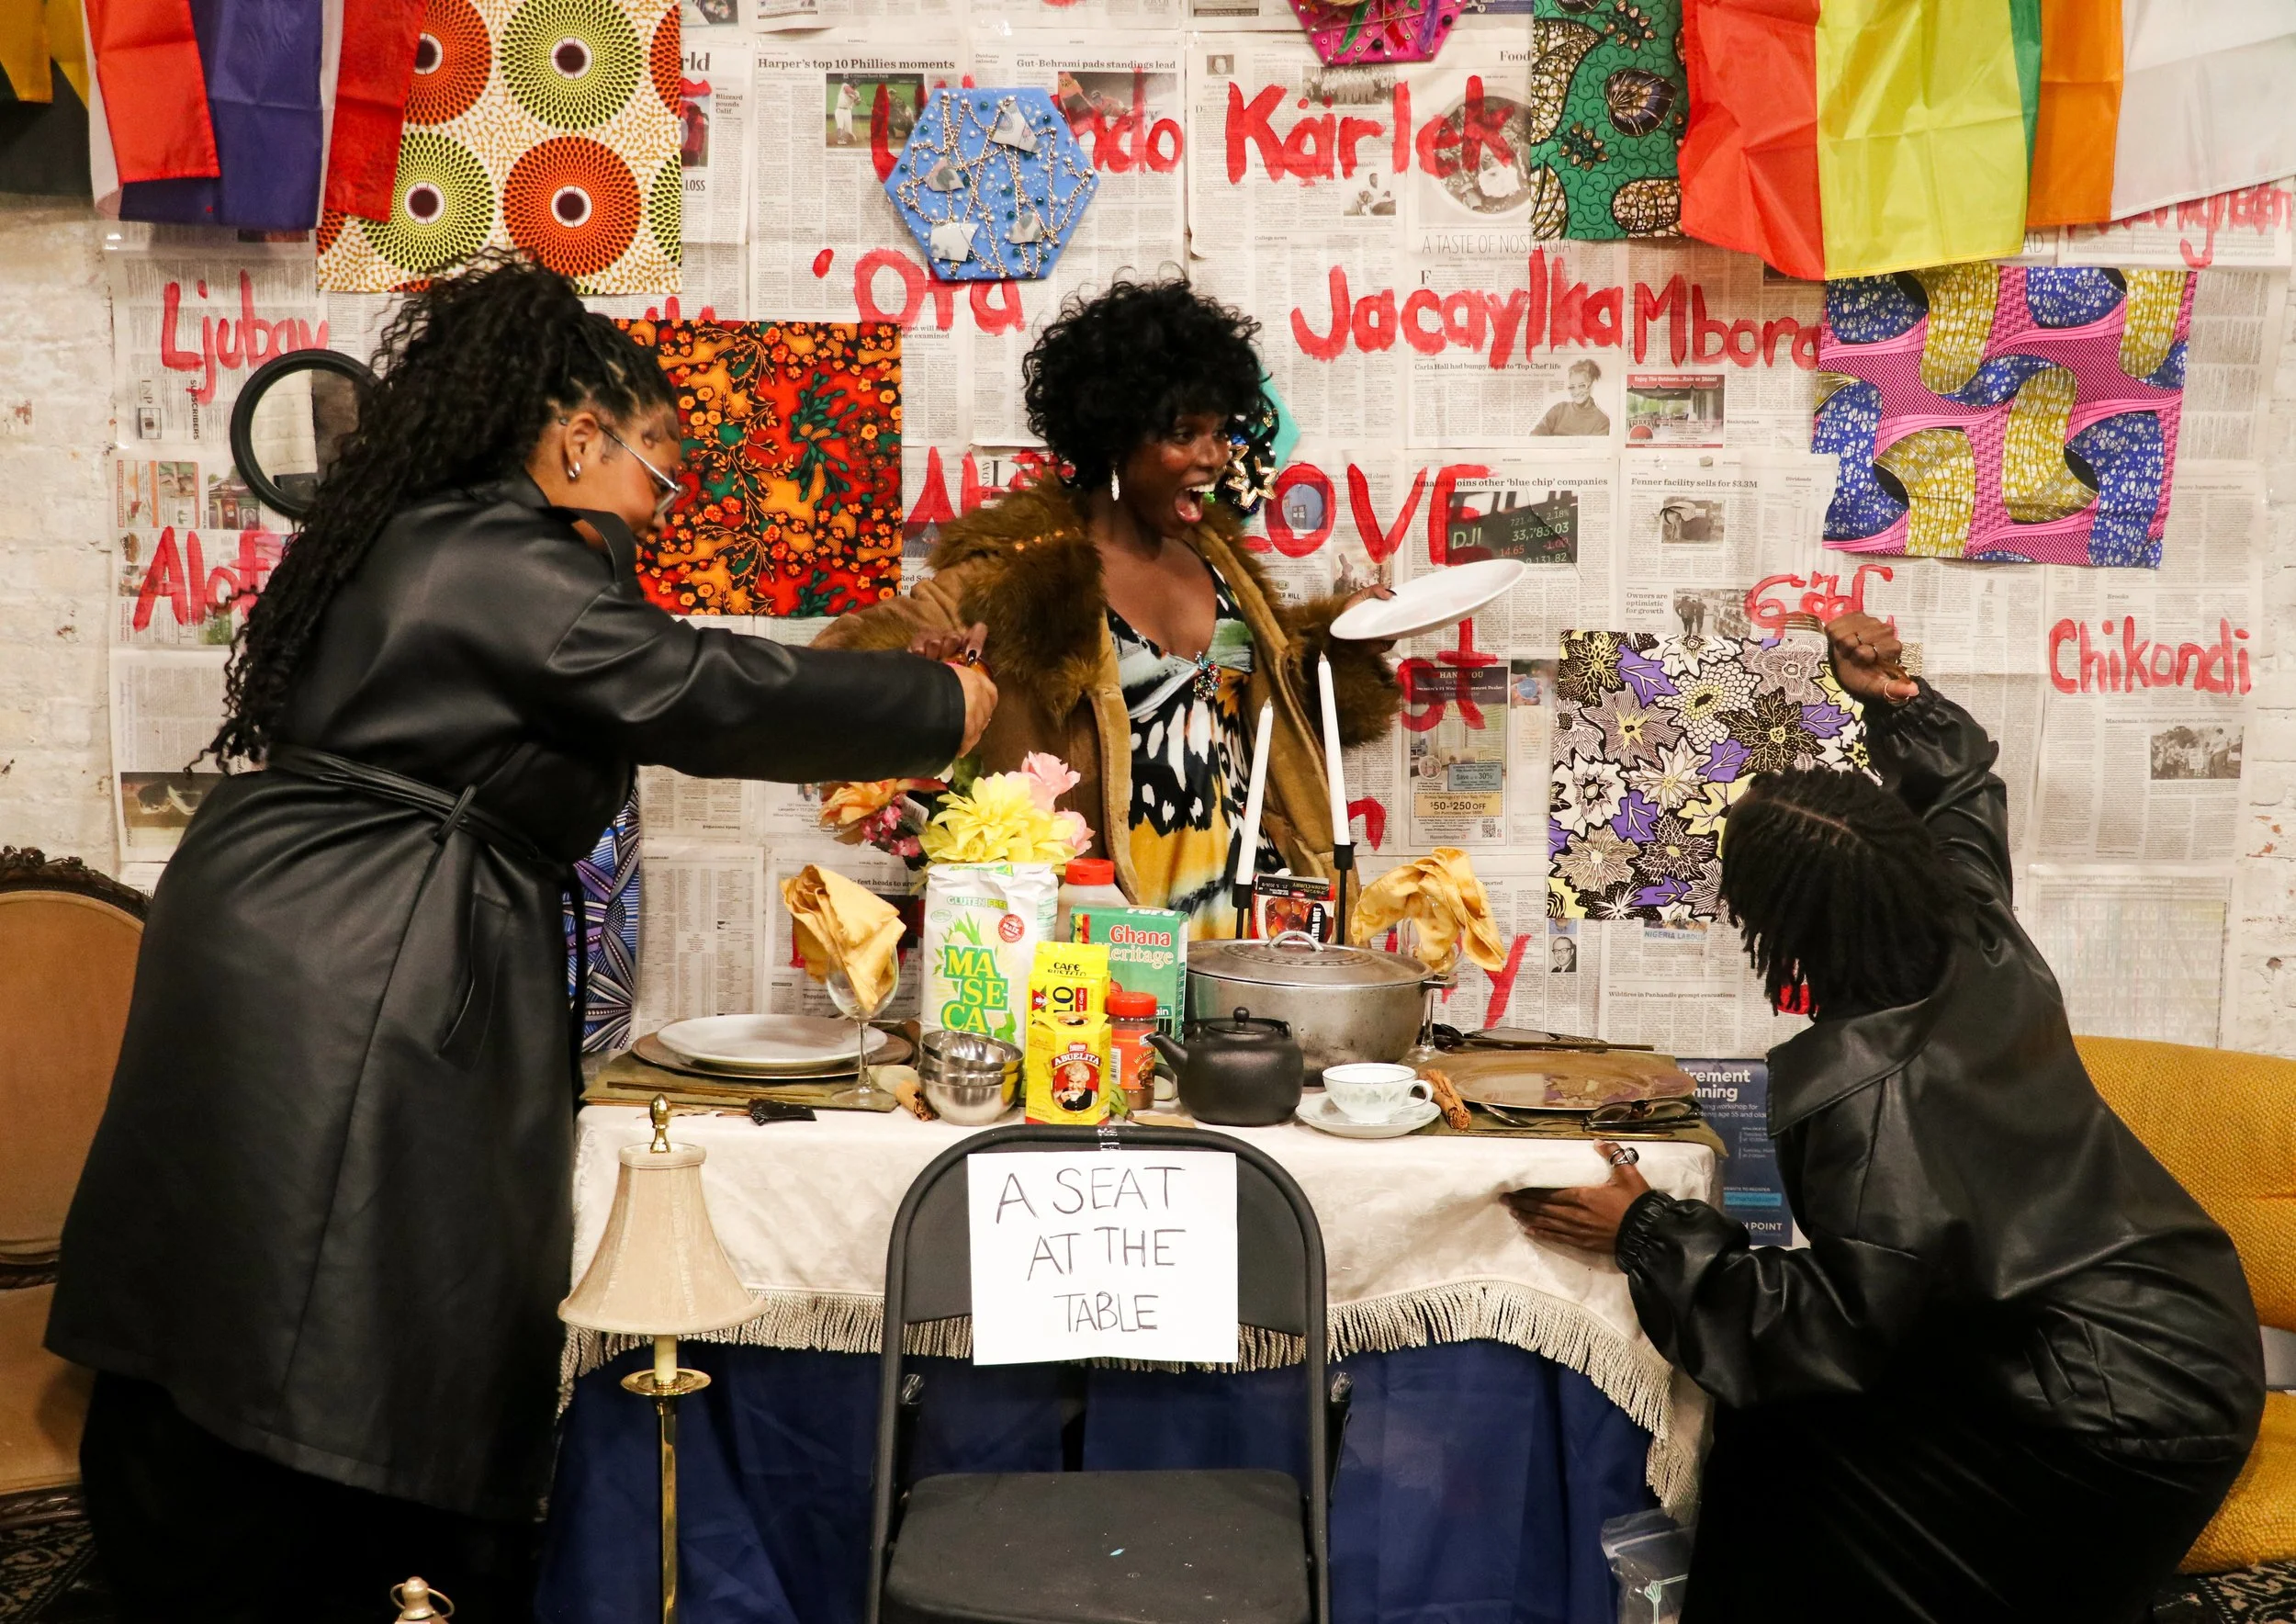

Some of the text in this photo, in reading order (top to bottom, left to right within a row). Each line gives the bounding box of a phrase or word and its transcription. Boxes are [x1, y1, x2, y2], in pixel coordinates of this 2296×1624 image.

[1500, 51, 1531, 62] Food
[758, 58, 955, 72] Harper’s top 10 Phillies moments
[1017, 59, 1176, 71] Gut-Behrami pads standings lead
[685, 180, 705, 191] LOSS
[1423, 235, 1432, 254] A
[1435, 234, 1474, 254] TASTE
[1478, 234, 1496, 254] OF
[1462, 363, 1487, 372] bumpy
[1557, 478, 1608, 488] companies
[1631, 479, 1662, 487] Fenner
[1664, 479, 1694, 489] facility
[1244, 462, 1502, 571] OVE
[1452, 527, 1482, 549] DJI
[1626, 600, 1664, 609] optimistic
[1640, 607, 1664, 616] growth
[2049, 615, 2252, 696] Chikondi
[947, 896, 1008, 911] GLUTEN FREE
[1312, 907, 1322, 922] HOT
[1109, 924, 1171, 946] Ghana
[1645, 930, 1707, 941] NIGERIA LABOU
[947, 948, 996, 978] MA
[1102, 944, 1174, 970] eritage
[962, 978, 1005, 1008] SE
[943, 1003, 987, 1032] CA
[1054, 1053, 1099, 1066] ABUELITA
[1692, 1084, 1739, 1102] nning
[996, 1167, 1186, 1224] A SEAT
[1750, 1223, 1783, 1231] POINT
[1027, 1226, 1187, 1281] AT THE
[1052, 1291, 1159, 1333] TABLE
